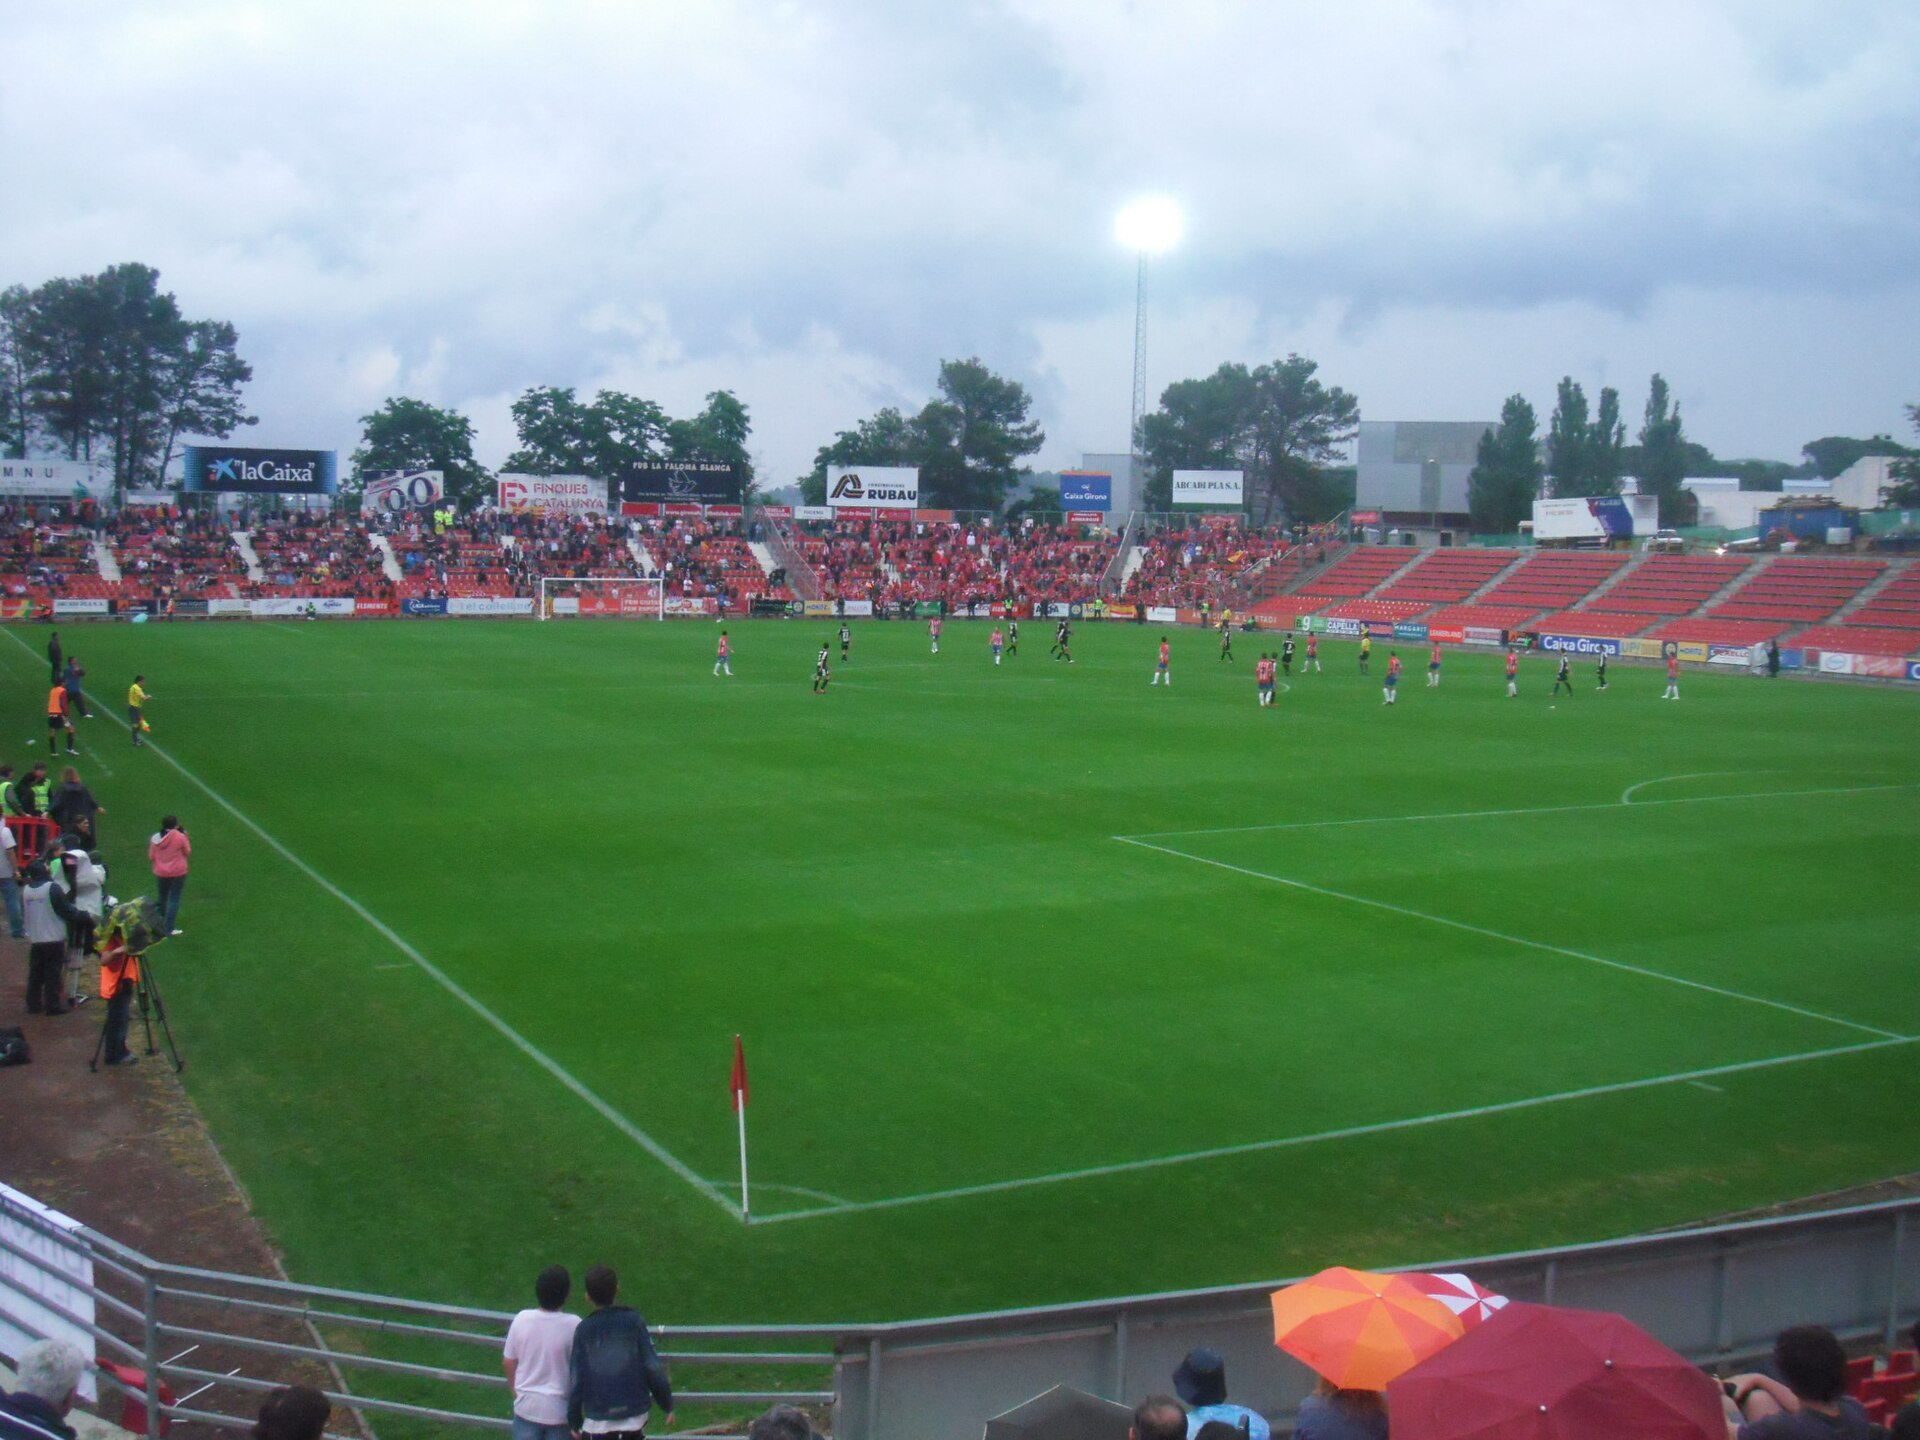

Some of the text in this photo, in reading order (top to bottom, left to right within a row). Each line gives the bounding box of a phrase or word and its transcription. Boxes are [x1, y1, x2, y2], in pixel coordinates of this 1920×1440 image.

[533, 482, 588, 494] FINQUES
[1174, 481, 1206, 489] ARCADI
[868, 489, 917, 501] RUBAU
[1064, 492, 1107, 500] Caixa Girona
[1327, 621, 1358, 630] CAPELLA
[1543, 636, 1616, 654] Caixa Giroa
